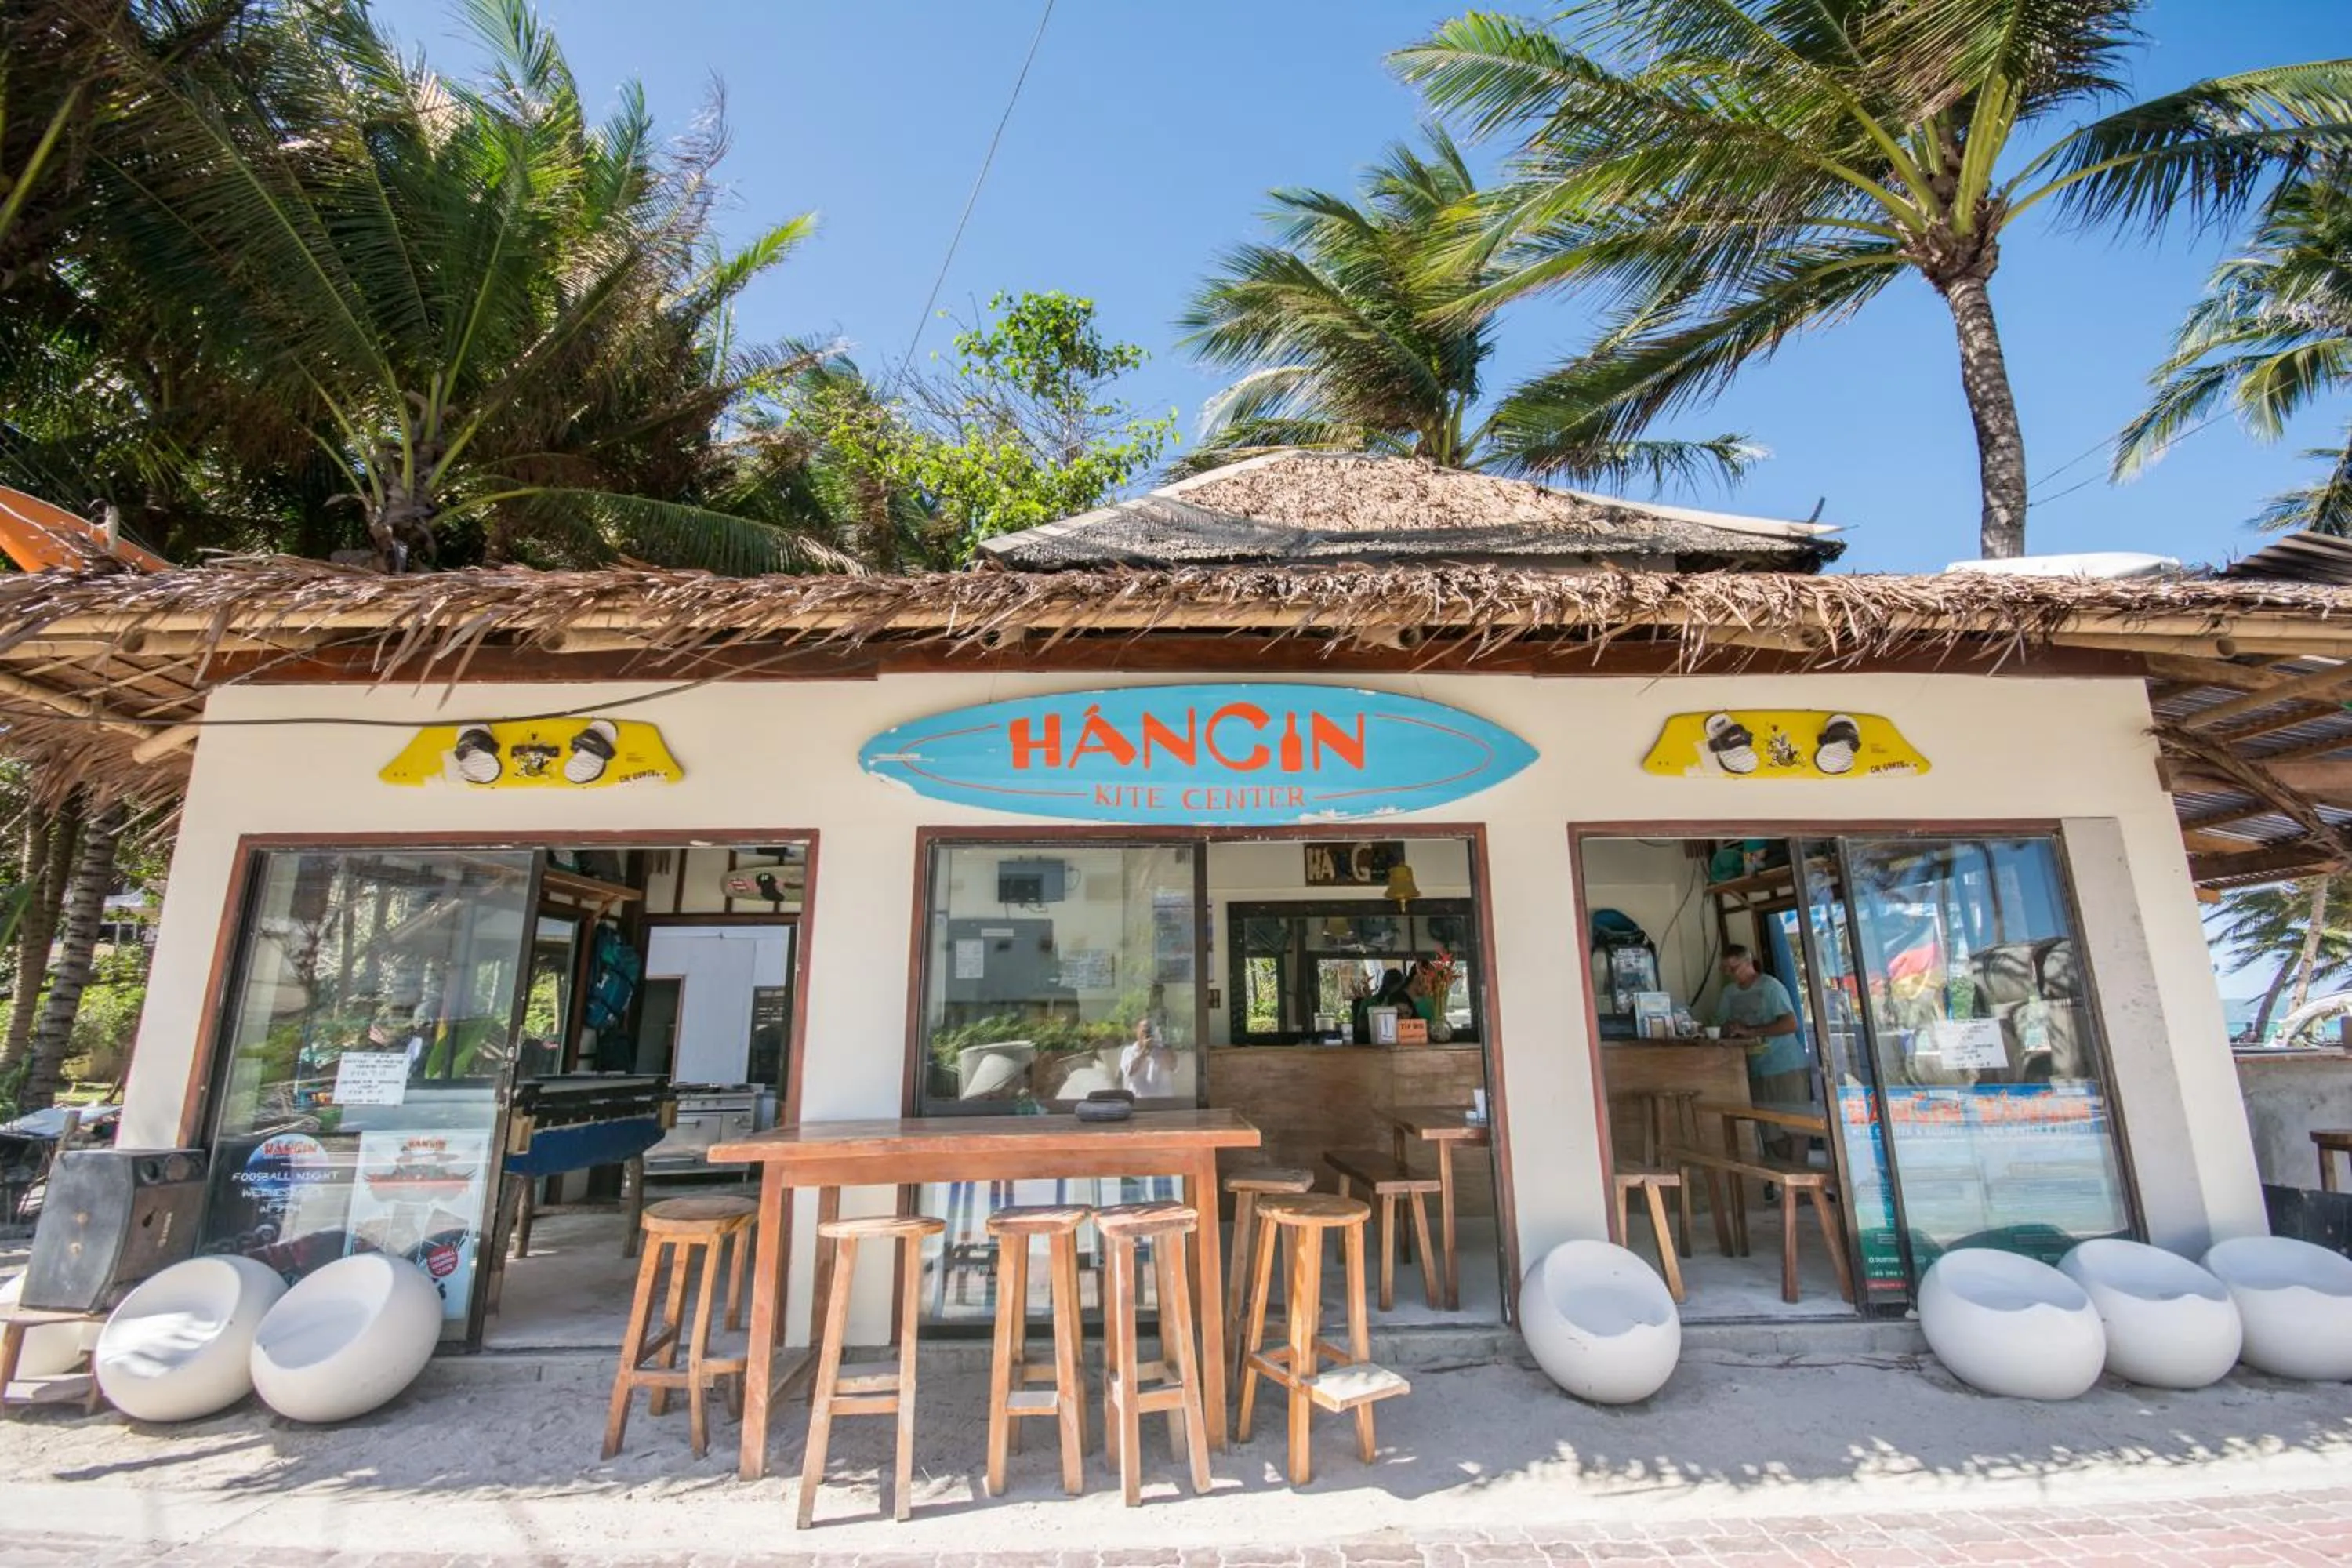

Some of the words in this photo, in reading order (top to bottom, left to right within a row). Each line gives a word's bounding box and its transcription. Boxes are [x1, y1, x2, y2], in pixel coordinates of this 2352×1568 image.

[1095, 785, 1167, 809] KITE
[1181, 786, 1305, 811] CENTER
[230, 1171, 291, 1182] FOOSBALL
[297, 1170, 340, 1181] NIGHT
